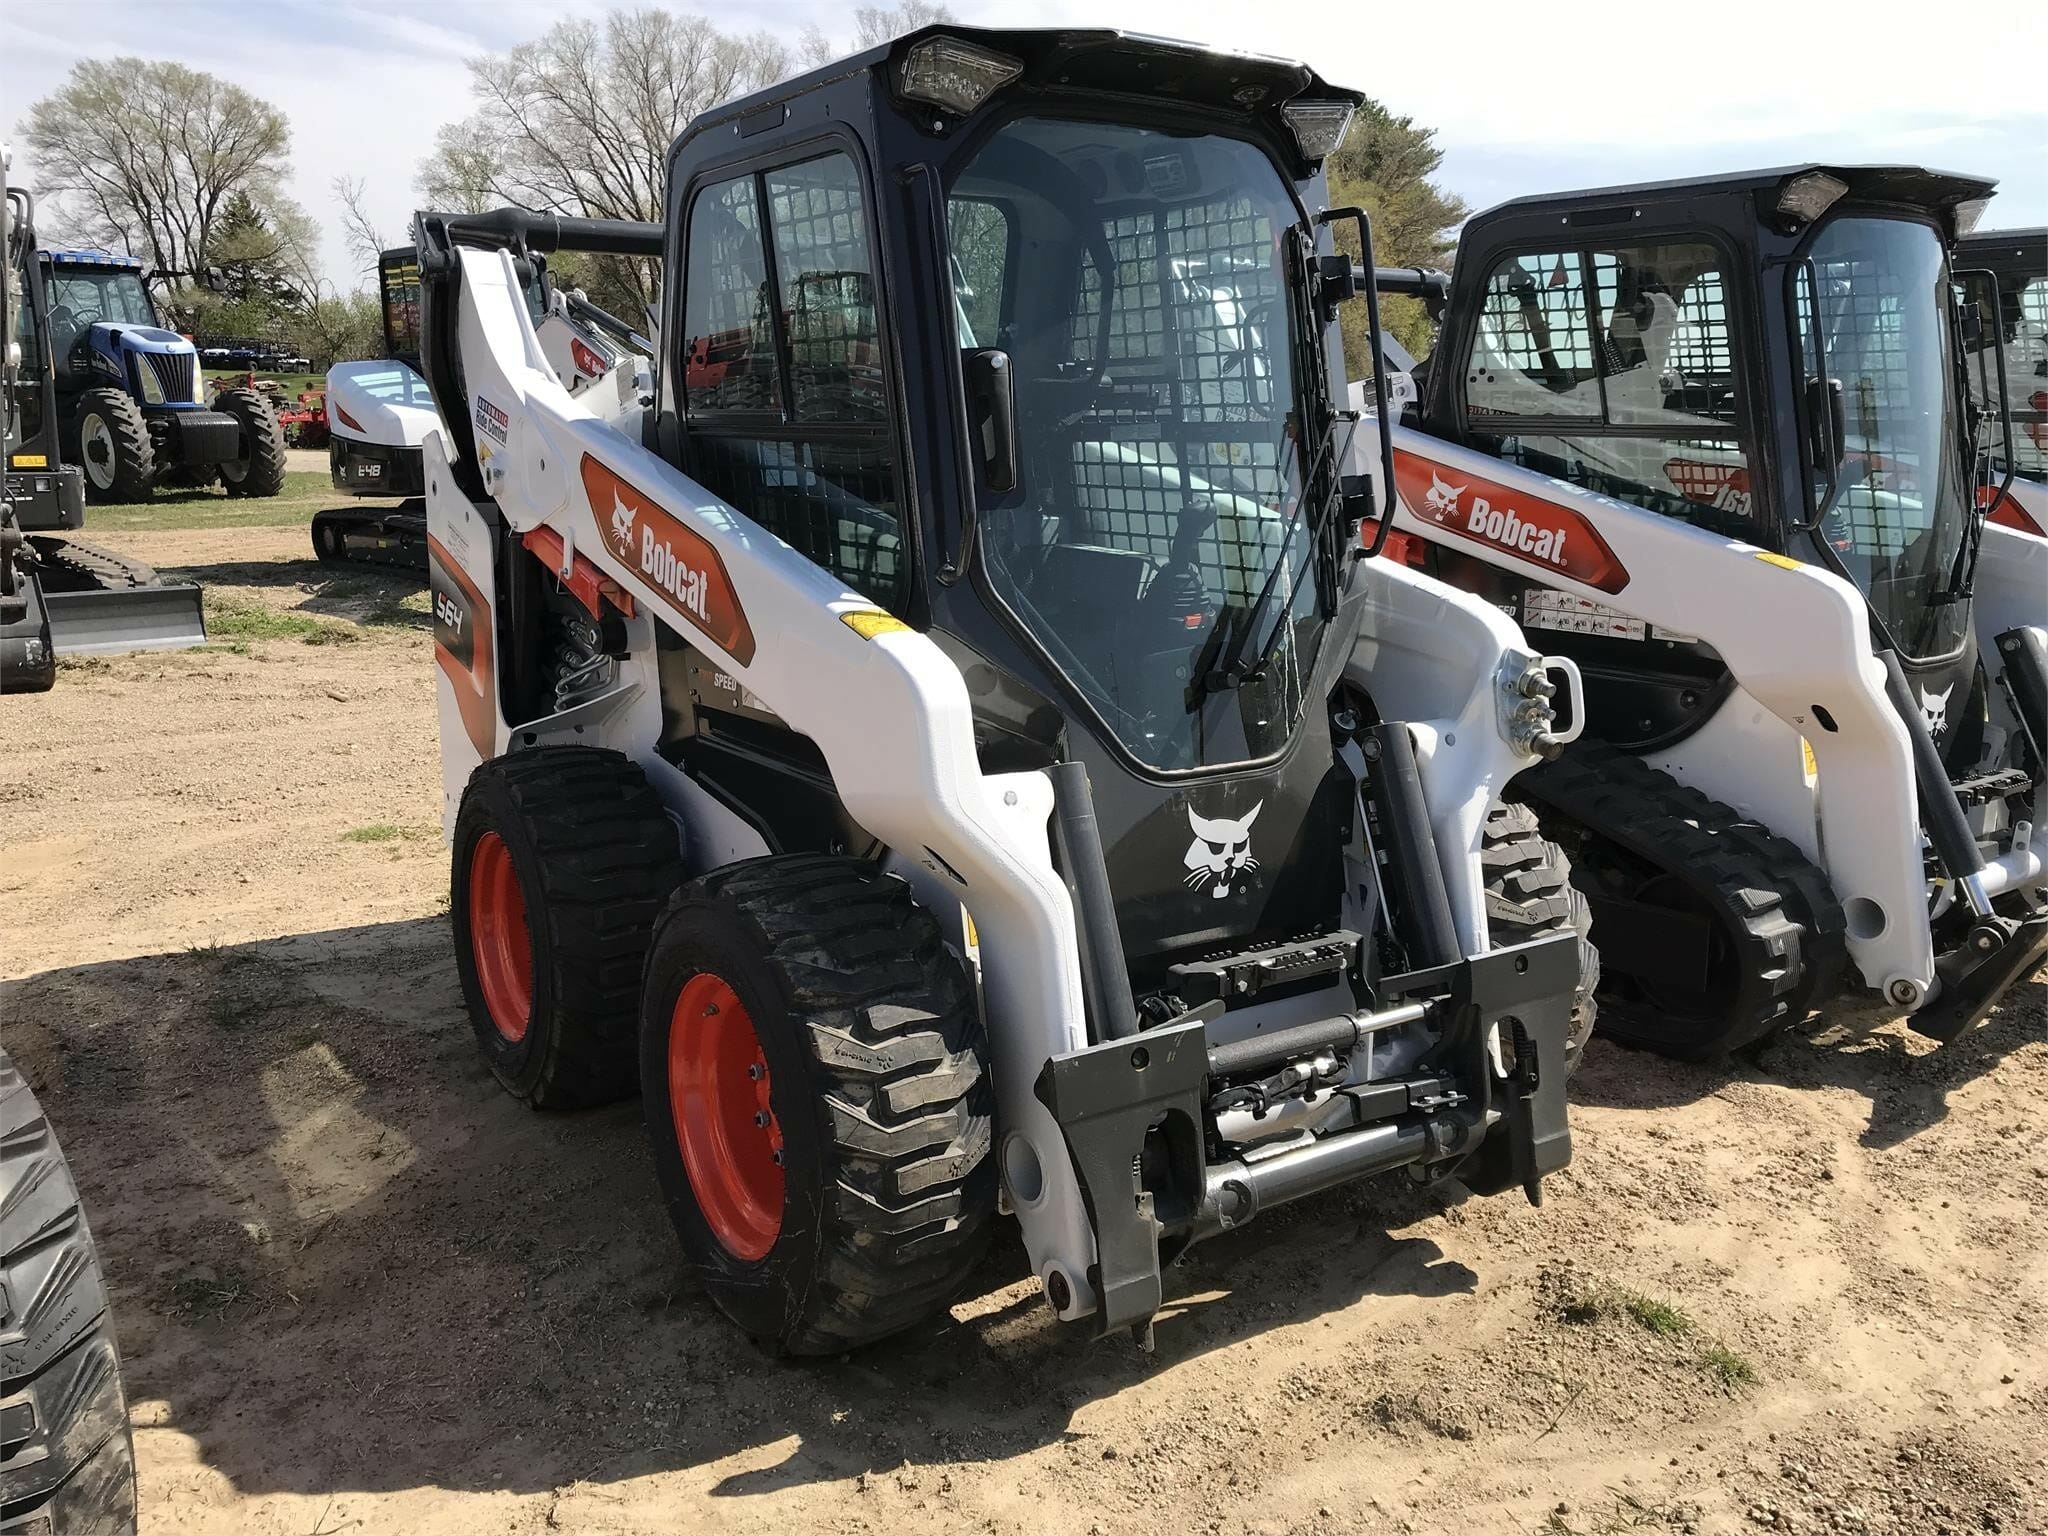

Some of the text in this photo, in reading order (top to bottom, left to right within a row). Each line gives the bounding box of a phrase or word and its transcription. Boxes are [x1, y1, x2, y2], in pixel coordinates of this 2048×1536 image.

[475, 408, 507, 445] Ride Control
[477, 395, 508, 427] AUTOMATIC
[358, 464, 381, 477] E48
[1467, 496, 1566, 565] Bobcat
[641, 523, 708, 621] Bobcat
[436, 591, 463, 635] S64
